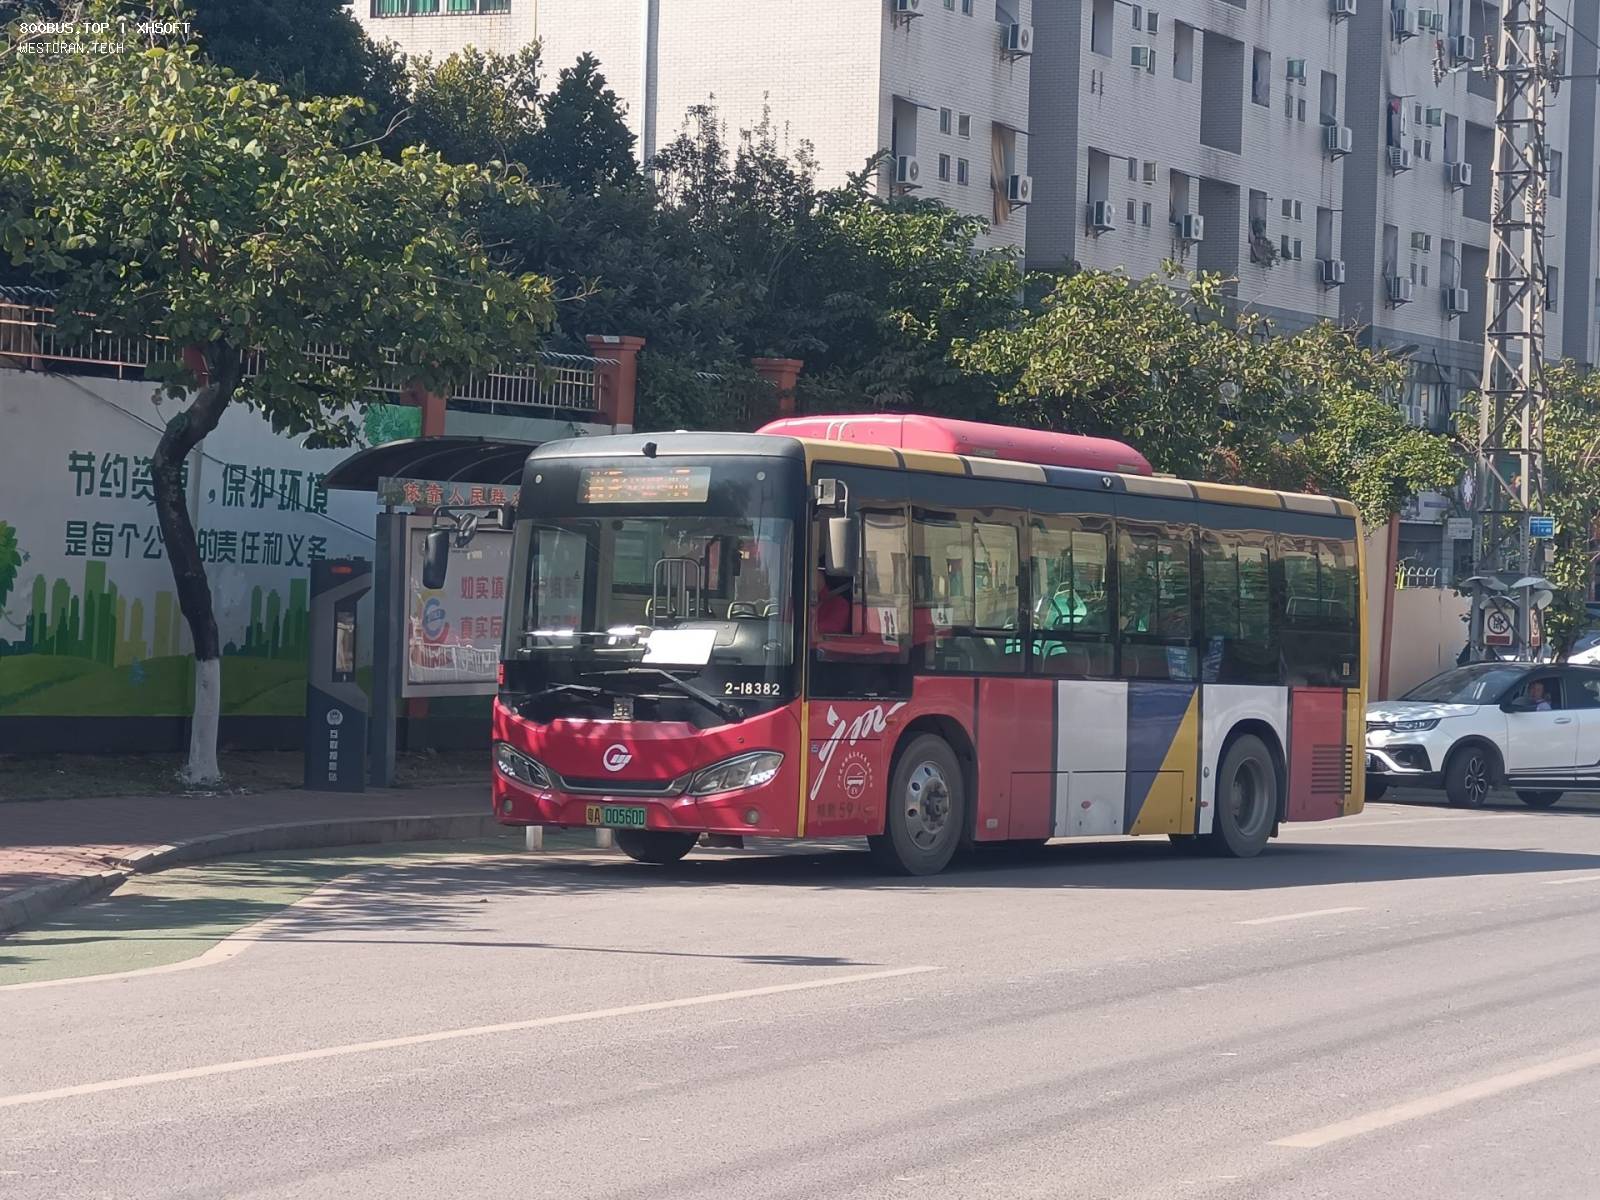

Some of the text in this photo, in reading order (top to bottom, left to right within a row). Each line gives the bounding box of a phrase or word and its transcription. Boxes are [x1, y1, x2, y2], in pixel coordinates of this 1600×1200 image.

[65, 520, 327, 568] 是每个公的责任和义务
[725, 682, 780, 696] 2-18382
